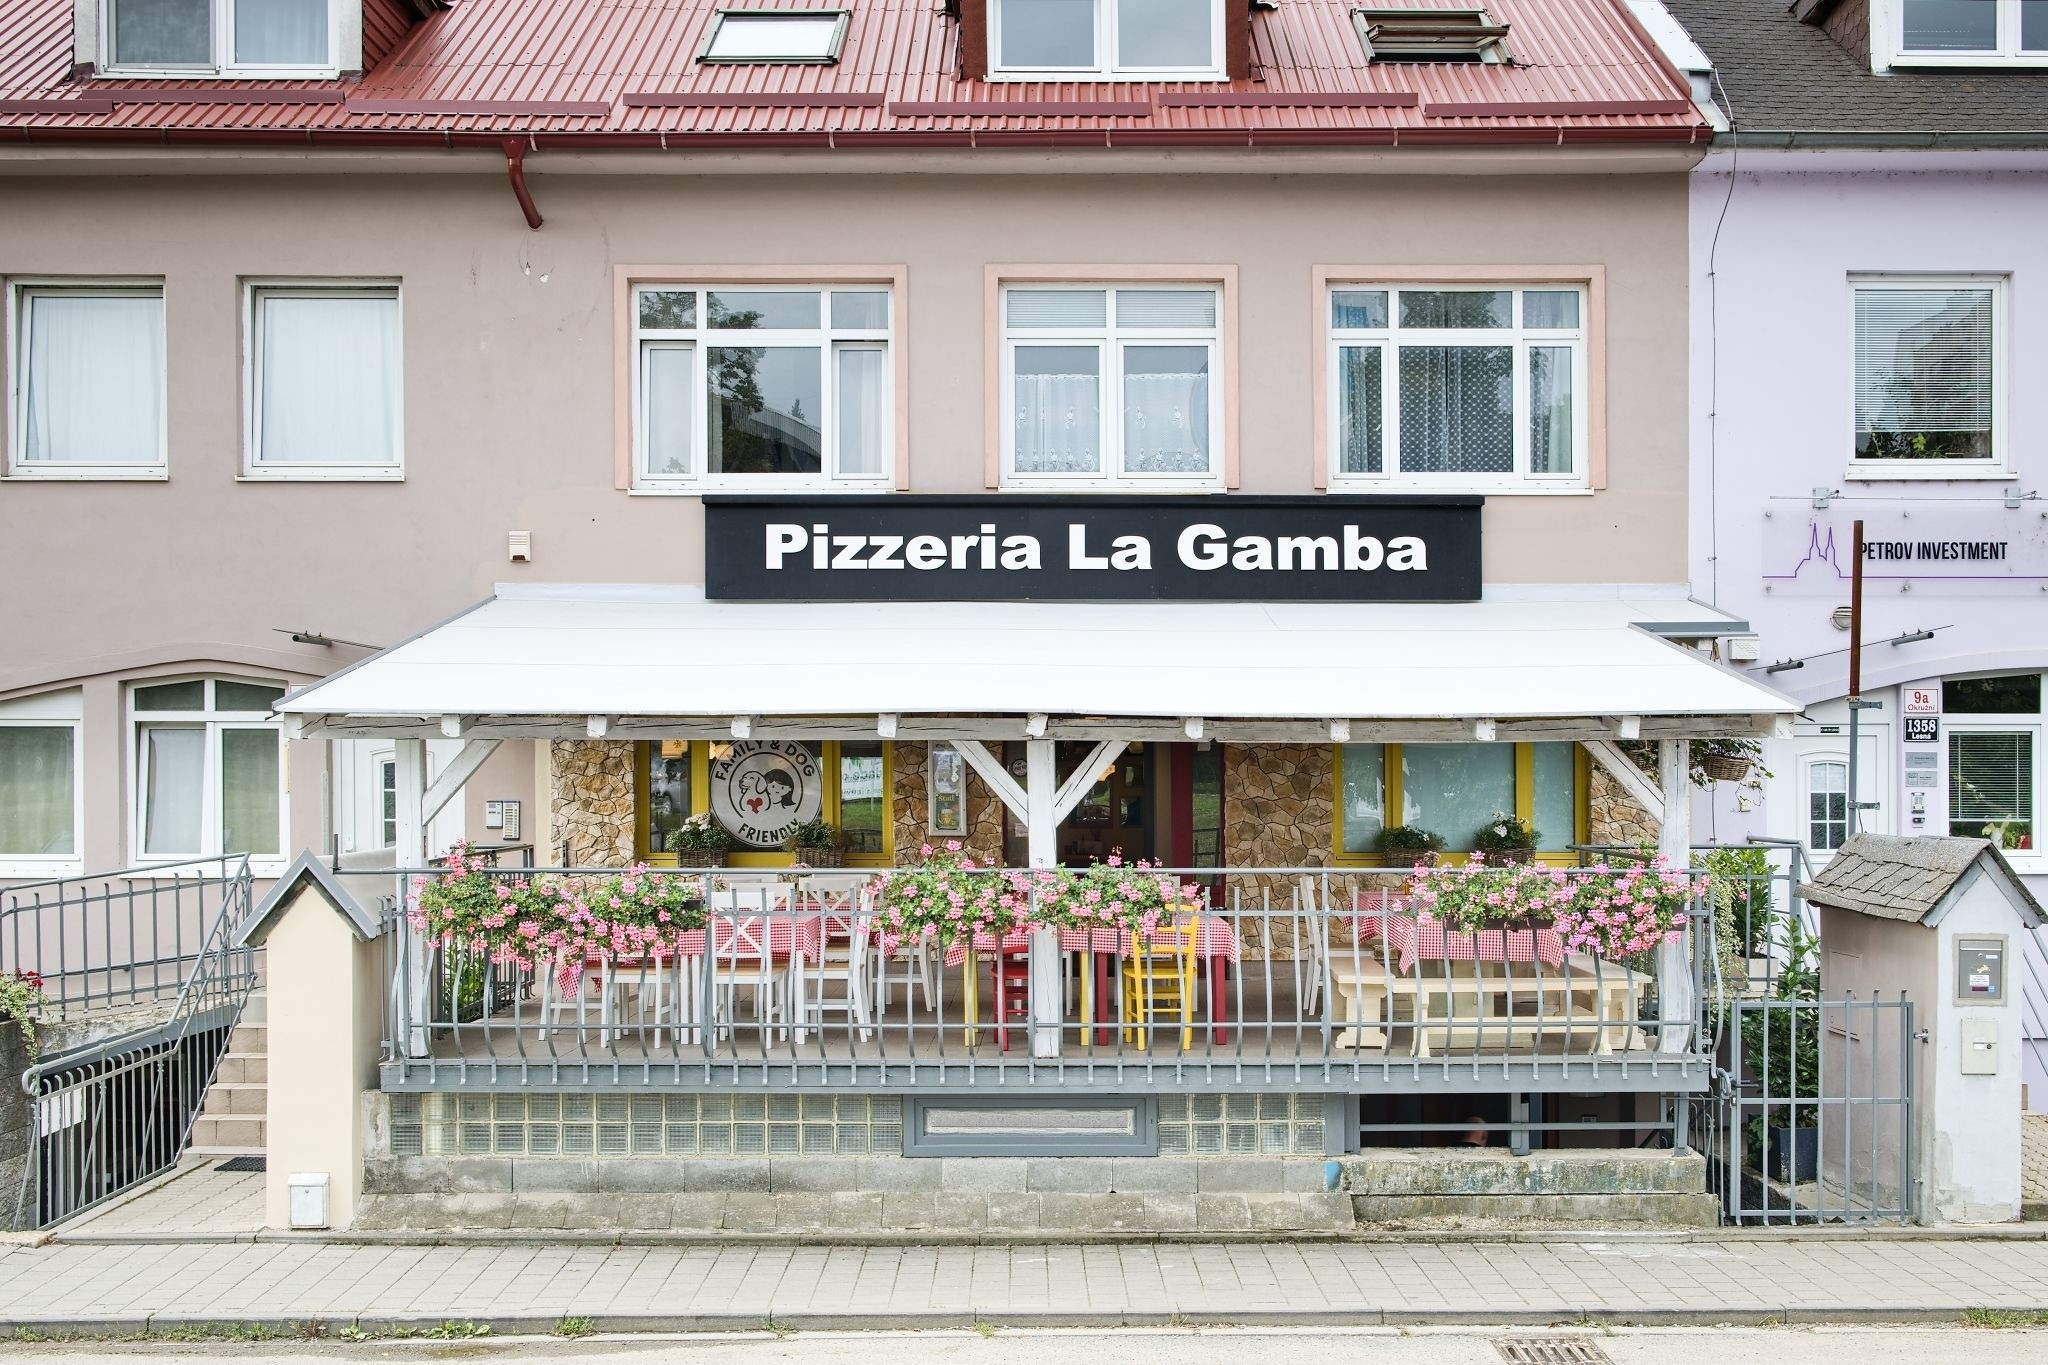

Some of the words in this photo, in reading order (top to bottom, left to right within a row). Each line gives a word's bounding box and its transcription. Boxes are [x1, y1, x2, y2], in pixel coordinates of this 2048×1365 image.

[765, 523, 1042, 571] Pizzeria
[1068, 523, 1153, 571] La
[1177, 523, 1428, 571] Gamba
[1861, 541, 1914, 560] PETROV
[1917, 541, 2008, 560] INVESTMENT
[1914, 691, 1929, 704] 9a
[1907, 719, 1937, 733] 1358
[1911, 732, 1932, 740] Lesná
[715, 740, 763, 781] FAMILY
[785, 743, 815, 777] DOG
[738, 818, 800, 843] FRIENDLY
